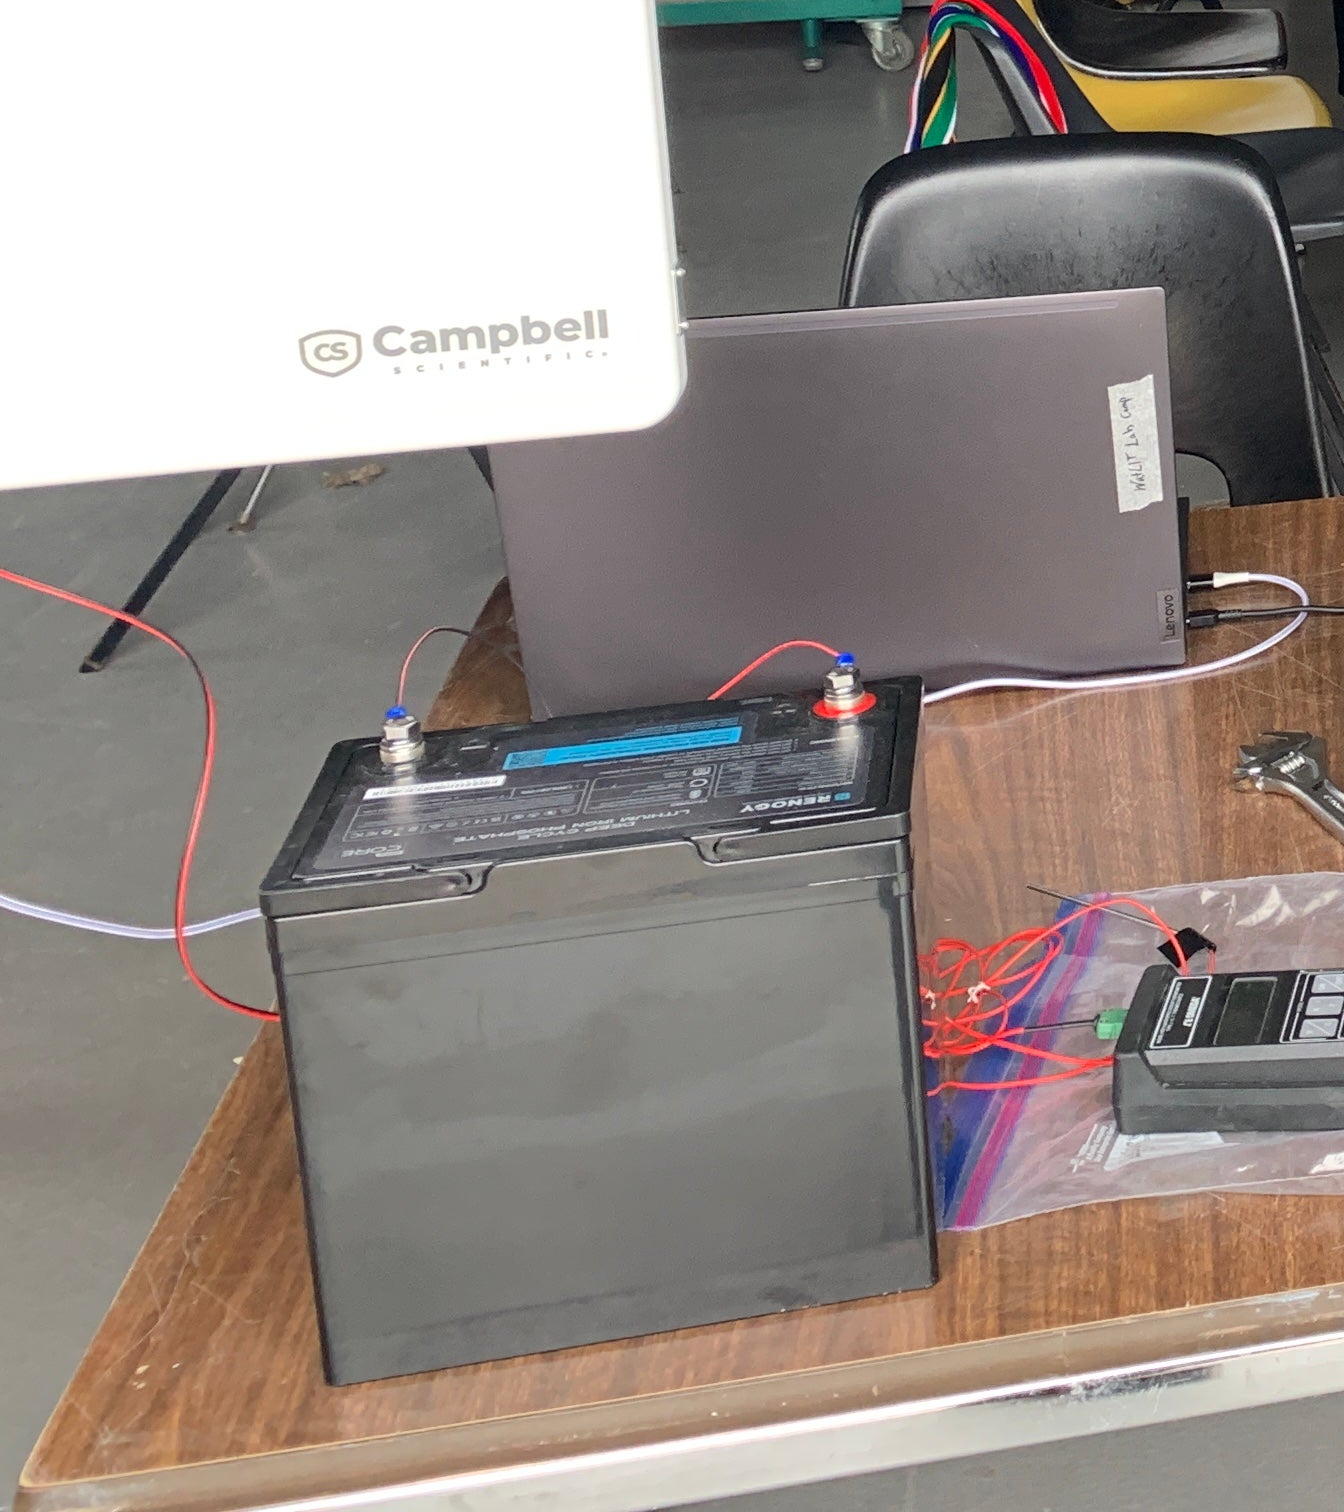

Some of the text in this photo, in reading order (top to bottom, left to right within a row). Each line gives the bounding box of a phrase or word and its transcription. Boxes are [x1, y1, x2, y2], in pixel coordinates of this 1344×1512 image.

[313, 309, 609, 363] CS Campbell
[393, 350, 594, 375] SCIENTIFIC
[1122, 424, 1139, 447] Lab
[1164, 594, 1175, 637] Lenovo
[739, 791, 836, 815] RENOGY
[619, 809, 689, 822] LITHIUM
[454, 824, 566, 843] PHOSPHATE
